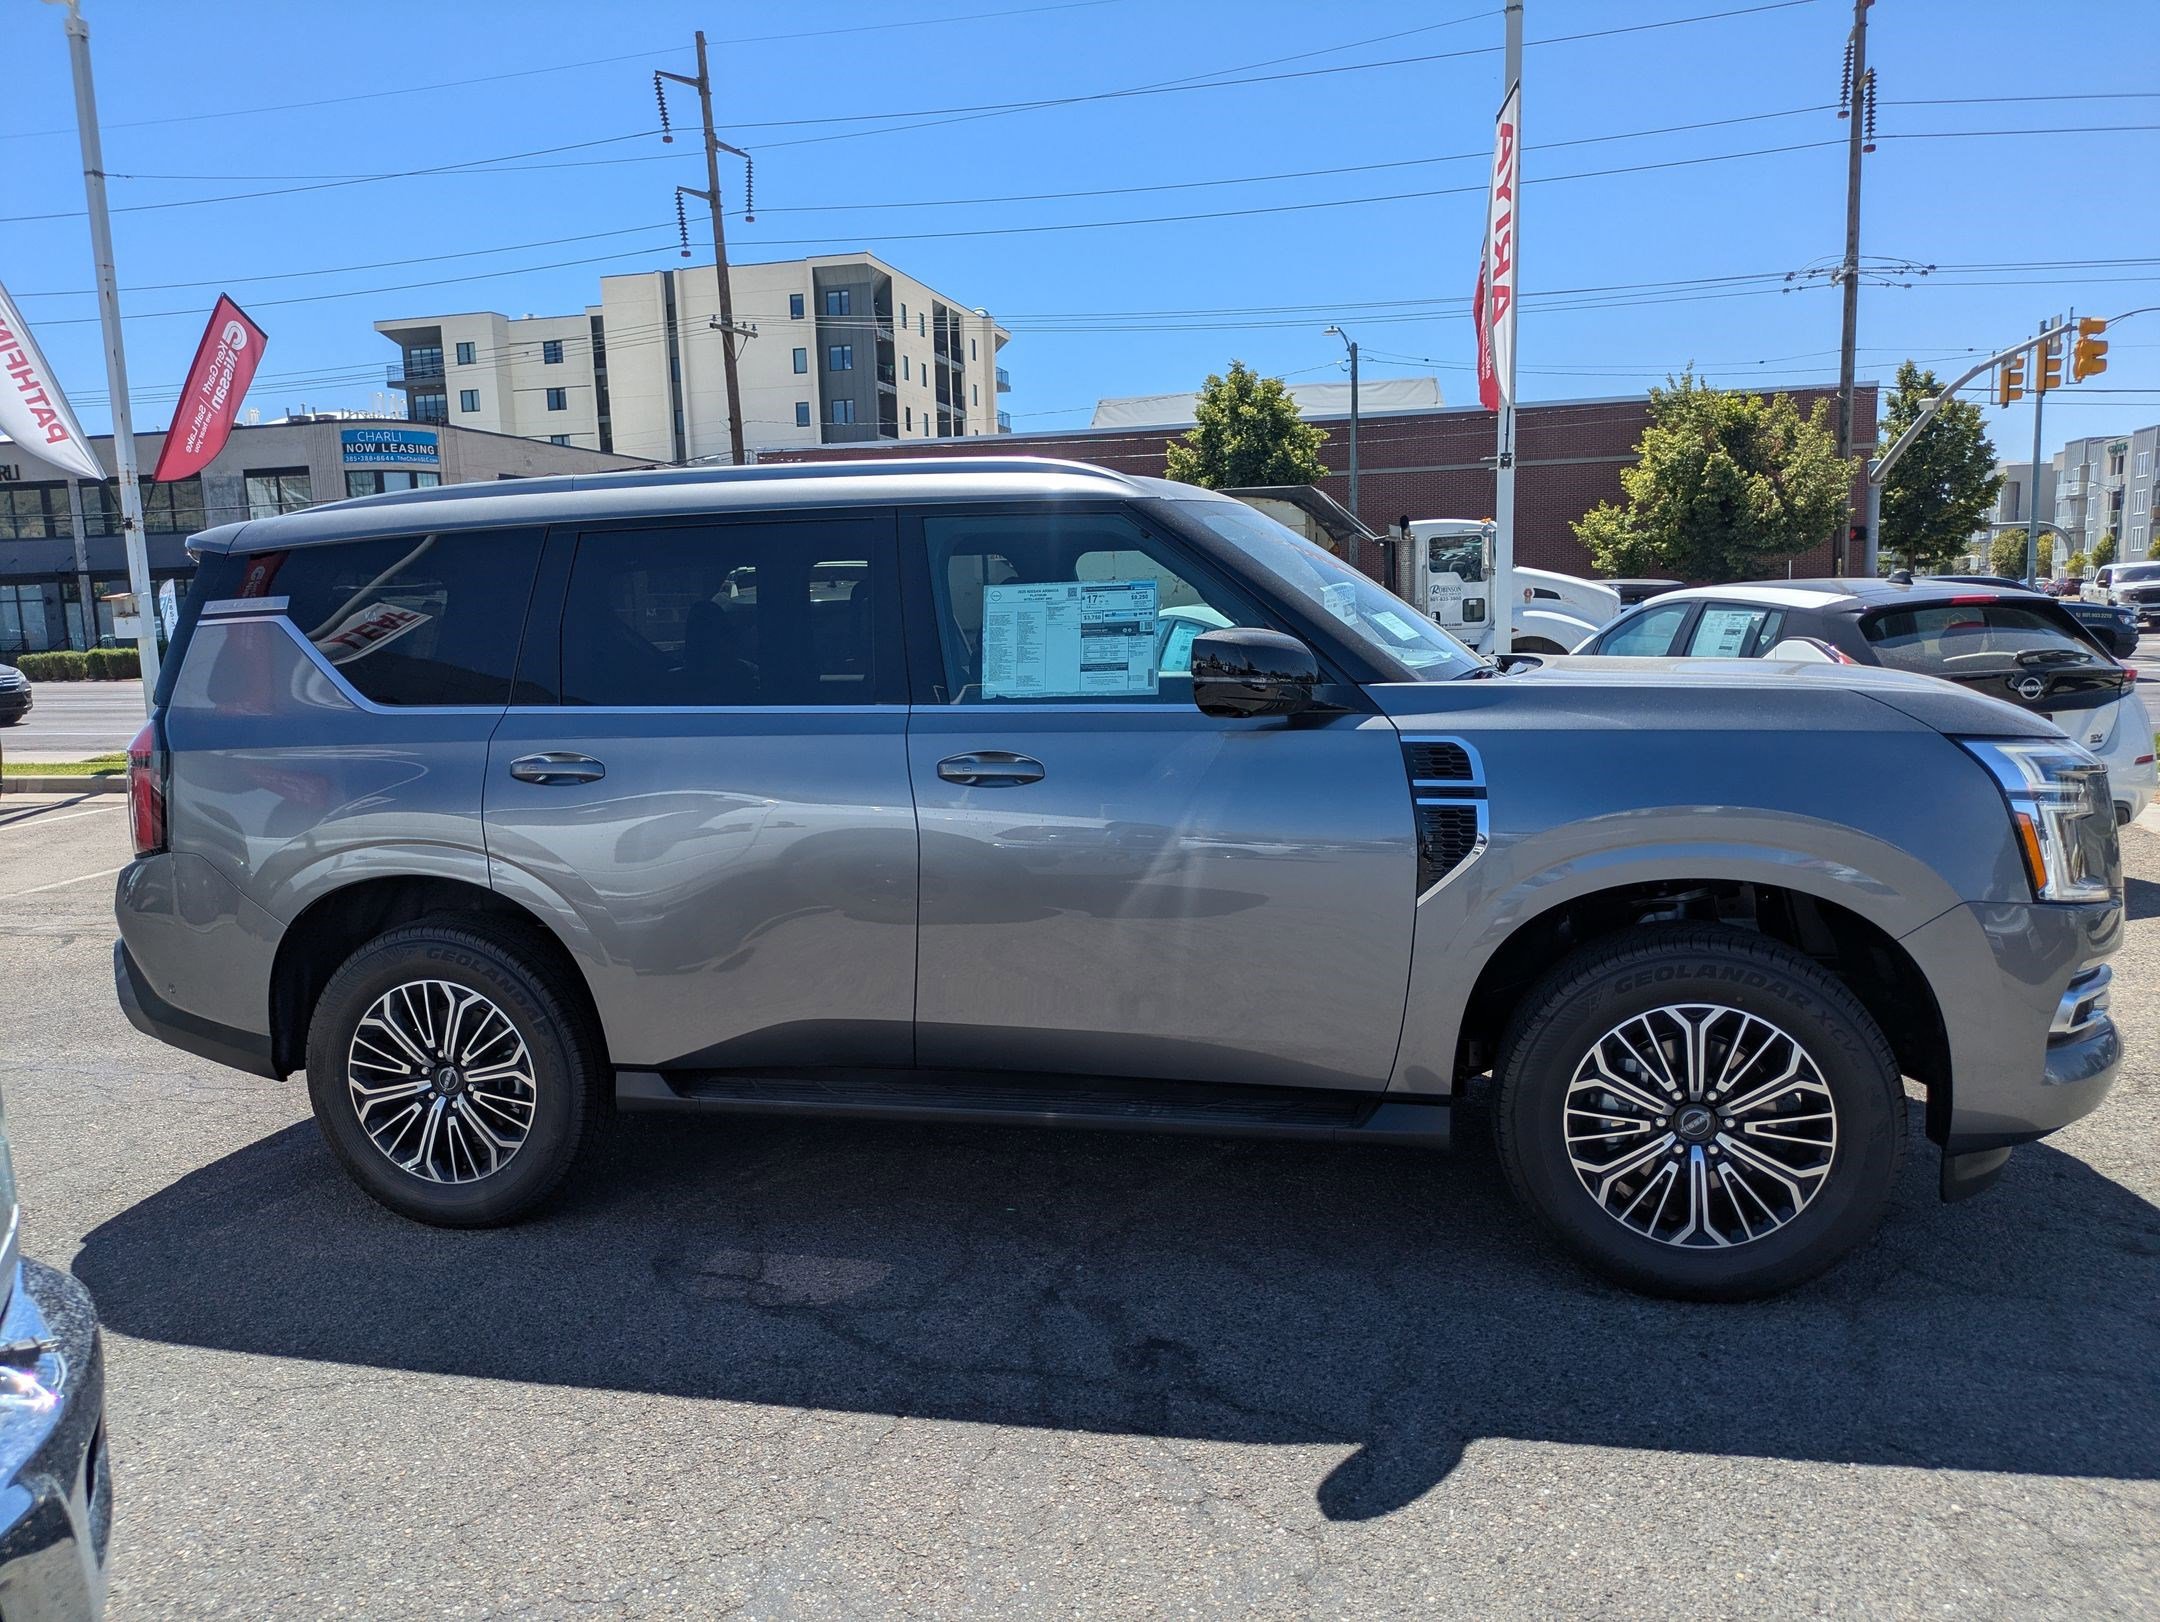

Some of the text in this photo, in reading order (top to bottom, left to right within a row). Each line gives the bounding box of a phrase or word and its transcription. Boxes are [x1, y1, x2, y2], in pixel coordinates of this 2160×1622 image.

[357, 431, 402, 442] CHARLI
[346, 443, 435, 455] NOW LEASING
[1086, 595, 1098, 604] 17
[1614, 963, 1814, 1013] GEOLANDAR
